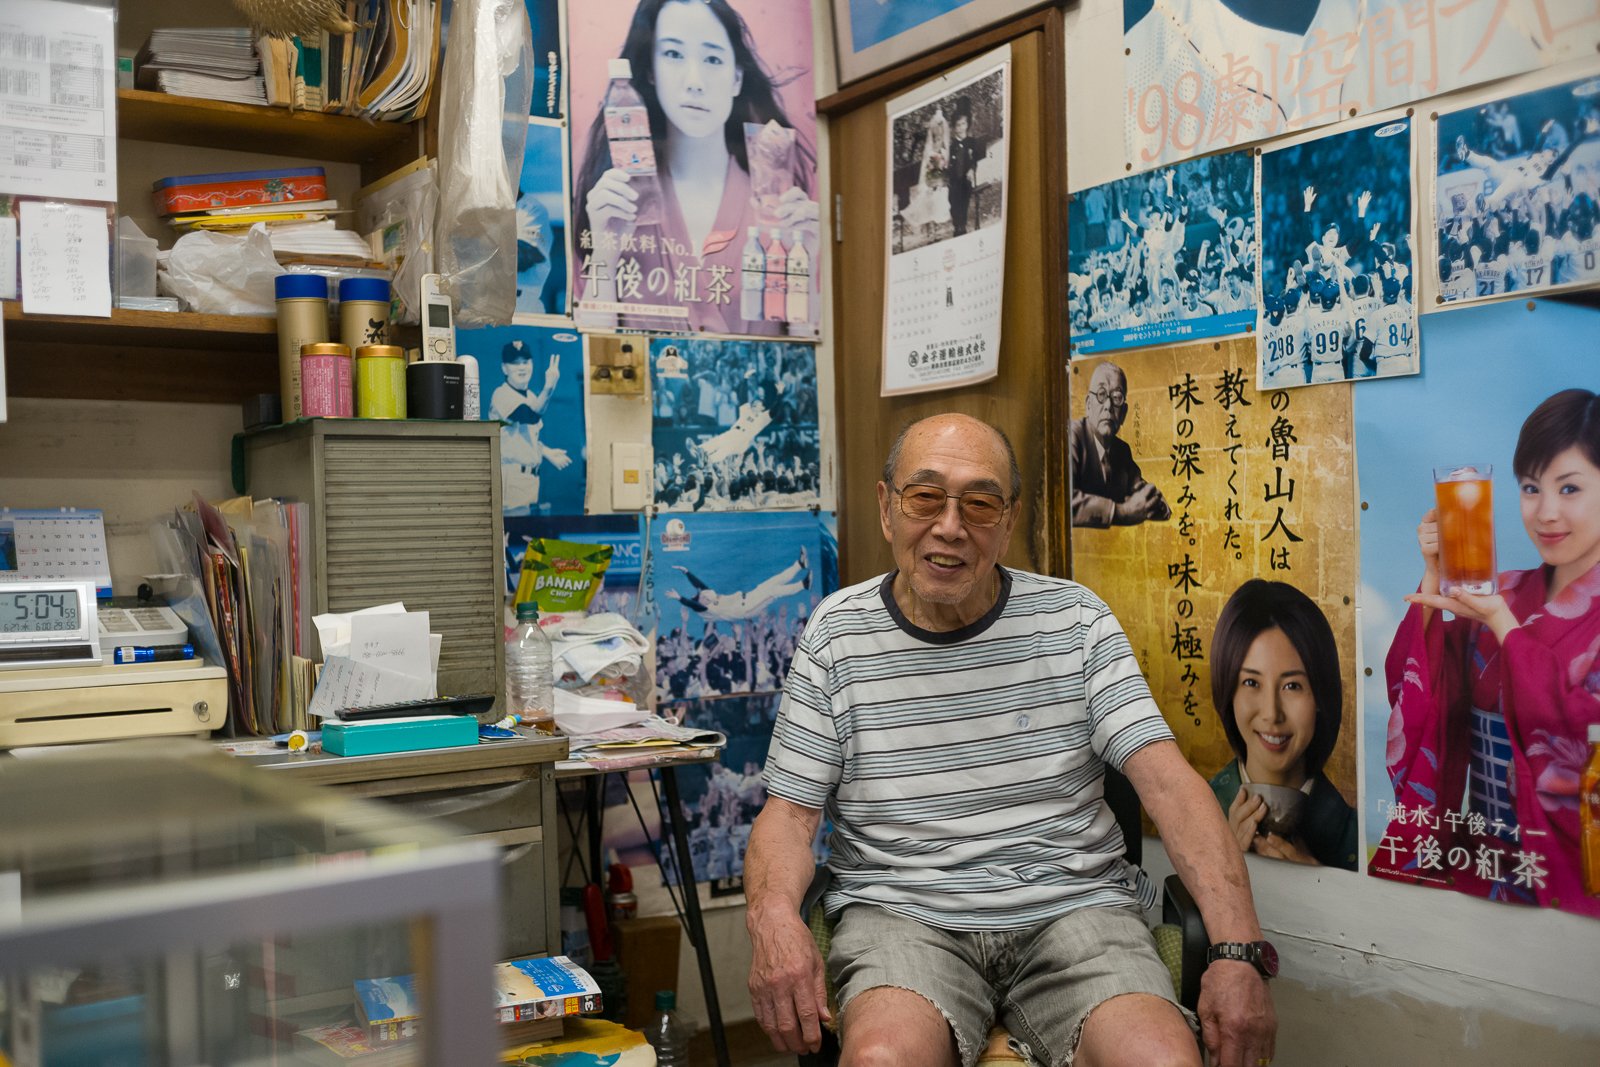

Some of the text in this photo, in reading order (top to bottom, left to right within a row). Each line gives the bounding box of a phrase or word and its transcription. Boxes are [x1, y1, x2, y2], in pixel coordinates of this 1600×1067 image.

[580, 229, 657, 255] 紅茶飲料
[579, 254, 734, 305] 午後の紅茶
[1478, 280, 1496, 297] 21
[1526, 266, 1544, 286] 17
[1315, 330, 1341, 355] 99
[1388, 322, 1408, 347] 84
[1268, 334, 1295, 362] 298
[1213, 367, 1252, 560] 教えてくれた。
[1261, 391, 1304, 571] の魯山人は
[534, 575, 591, 591] BANANA
[14, 594, 76, 620] 5:04 59
[1377, 799, 1548, 842] 「純水」午後ティー
[1378, 831, 1549, 889] 午後の紅茶
